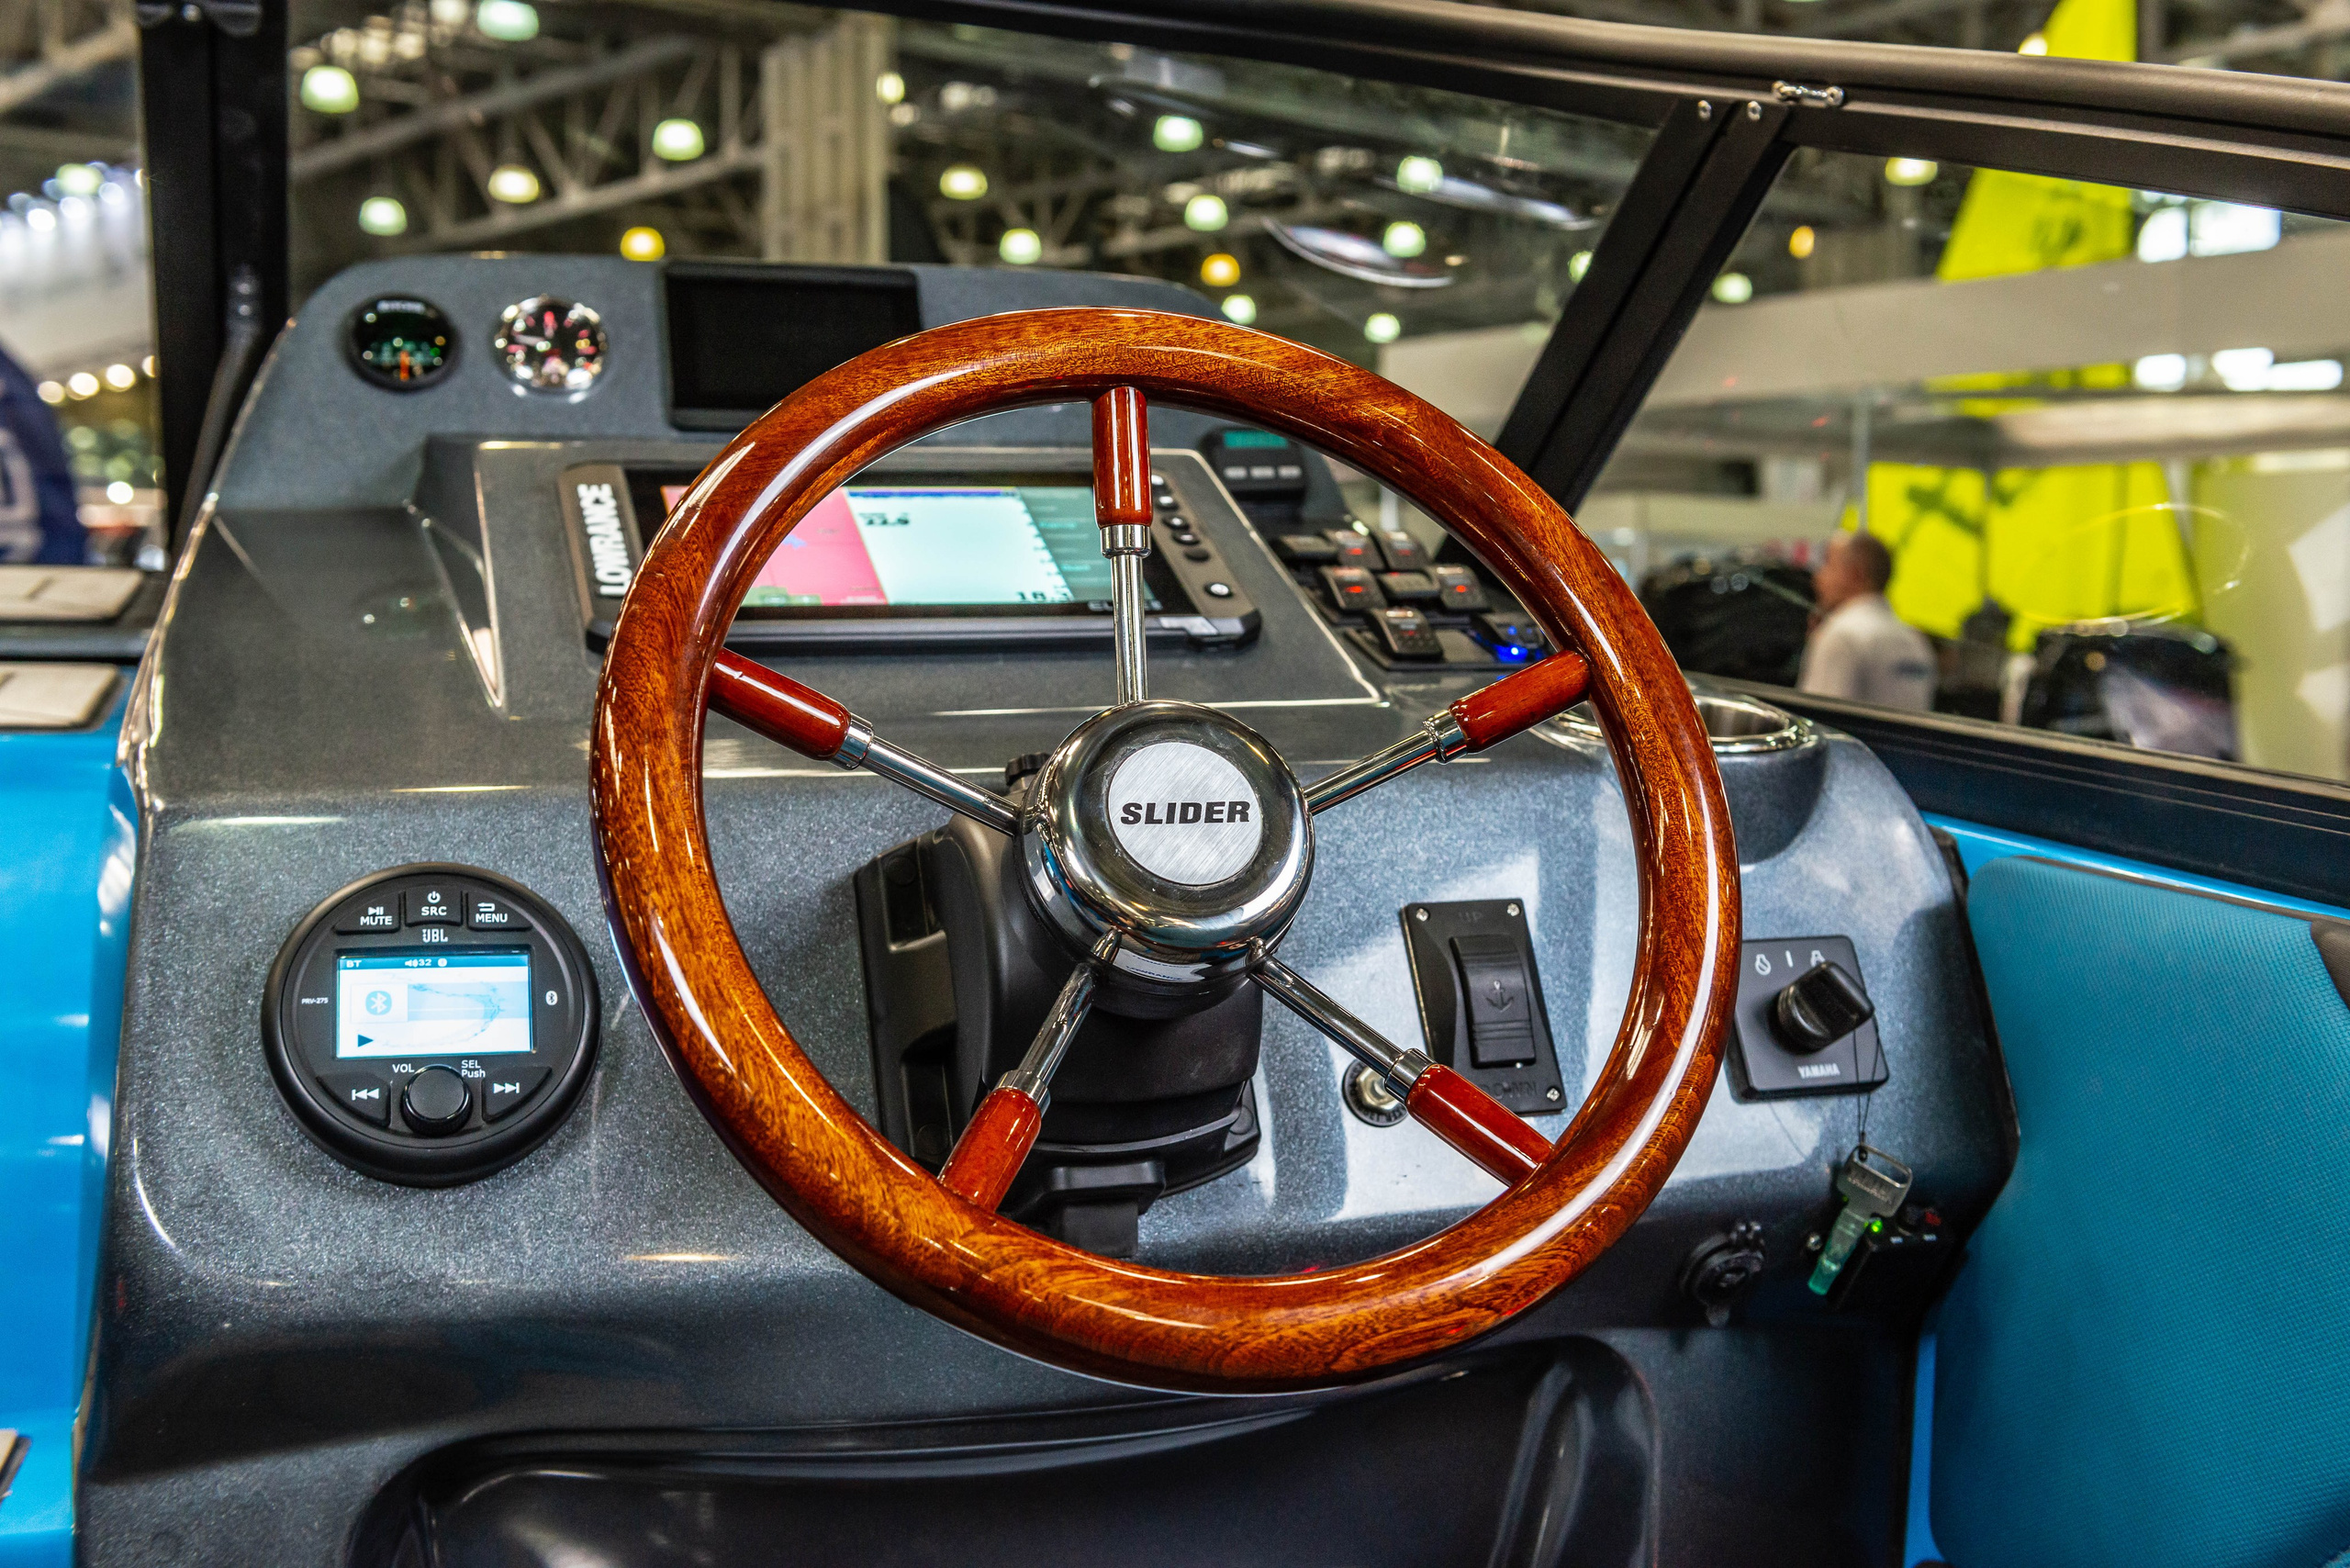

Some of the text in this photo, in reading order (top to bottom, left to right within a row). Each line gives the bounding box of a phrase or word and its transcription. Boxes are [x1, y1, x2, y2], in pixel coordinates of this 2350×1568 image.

[576, 483, 633, 595] LOWRANCE
[1120, 801, 1251, 825] SLIDER
[420, 906, 447, 916] SRC
[360, 915, 393, 926] MUTE
[475, 913, 508, 924] MENU
[422, 928, 448, 943] JBL
[346, 959, 362, 969] BT
[392, 1063, 415, 1073] VOL
[461, 1059, 481, 1069] SEL
[461, 1069, 486, 1078] Push
[1797, 1063, 1841, 1080] YAMAHA
